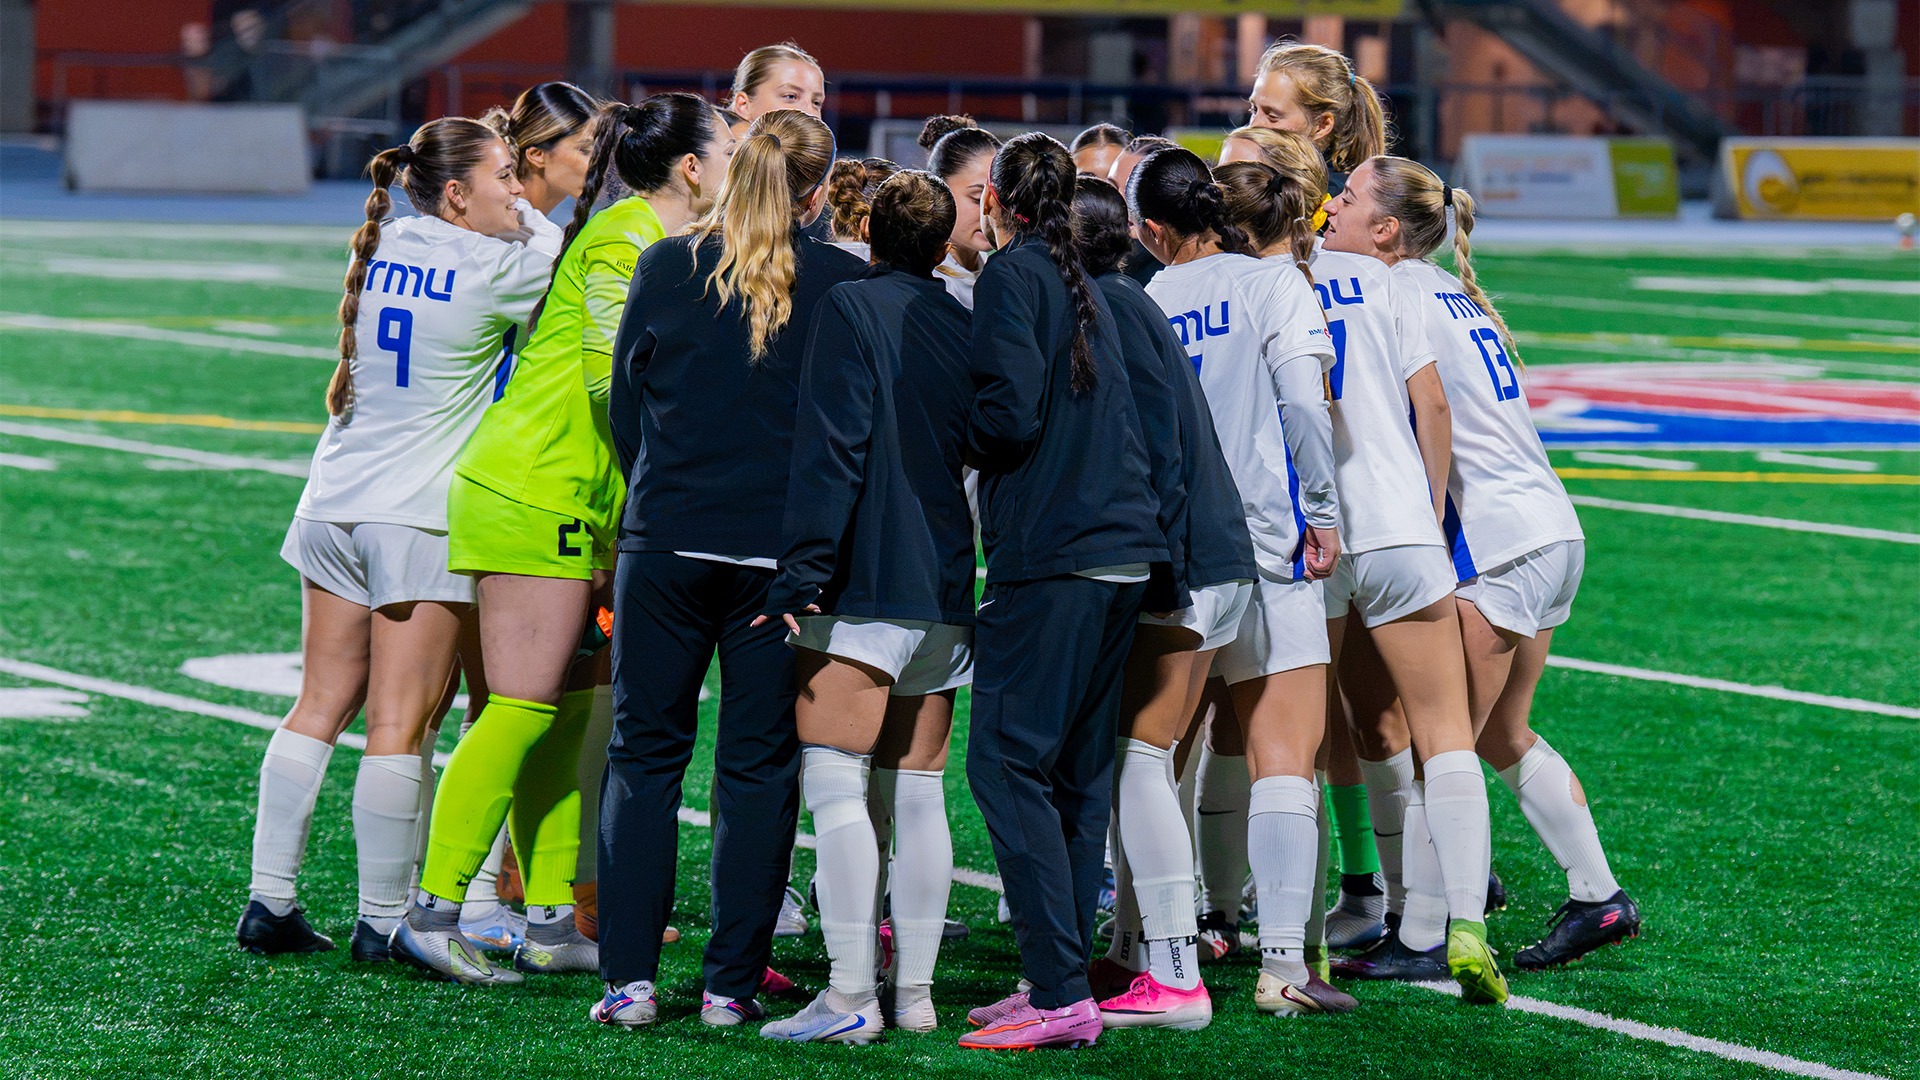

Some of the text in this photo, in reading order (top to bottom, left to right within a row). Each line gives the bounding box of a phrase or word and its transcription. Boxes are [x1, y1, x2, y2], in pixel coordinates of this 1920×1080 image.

[1168, 300, 1230, 347] MU
[1434, 292, 1487, 320] TM
[377, 306, 413, 388] 9
[1469, 327, 1520, 402] 13
